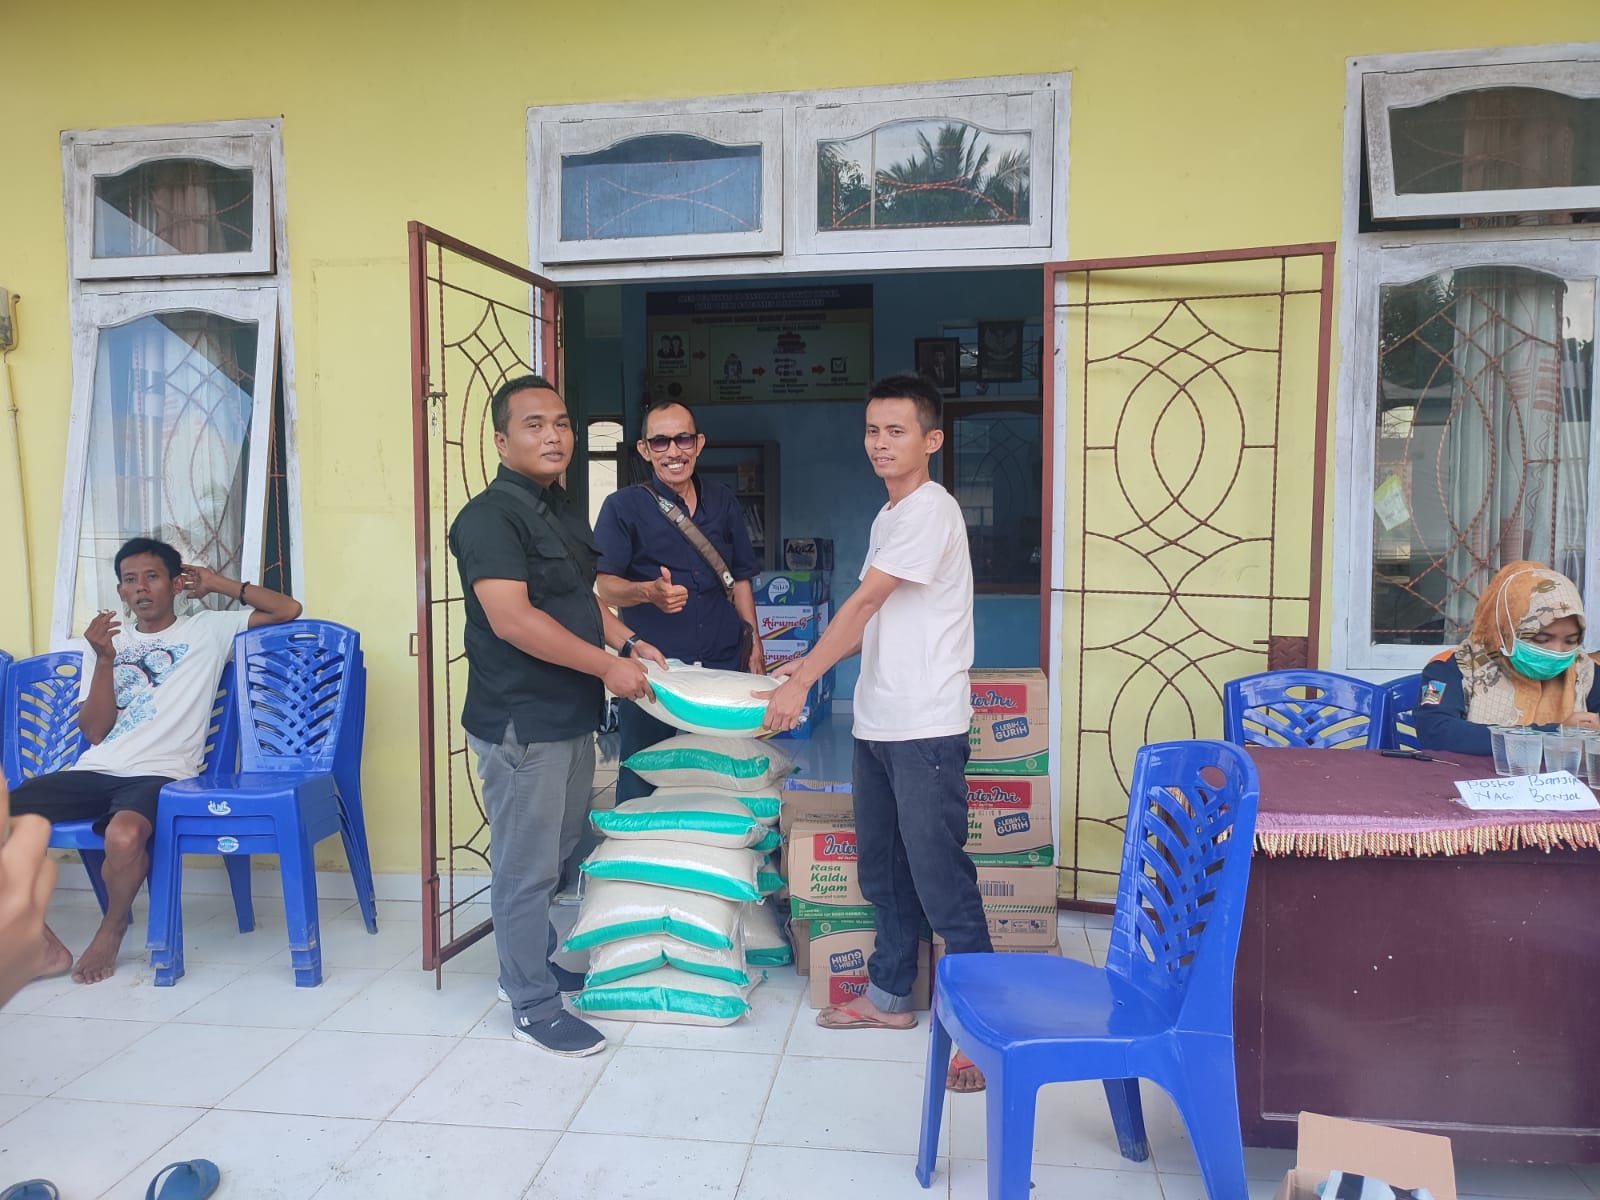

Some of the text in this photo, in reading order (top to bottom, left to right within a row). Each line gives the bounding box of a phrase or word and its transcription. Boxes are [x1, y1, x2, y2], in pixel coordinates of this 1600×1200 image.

[1000, 721, 1020, 731] LEBIH
[995, 726, 1028, 740] GURIH
[1001, 815, 1021, 825] LEBIH
[997, 821, 1029, 834] GURIH
[811, 864, 841, 872] Rasa
[810, 873, 848, 882] Kaldu
[810, 883, 848, 895] Ayam
[831, 950, 861, 964] GURIH
